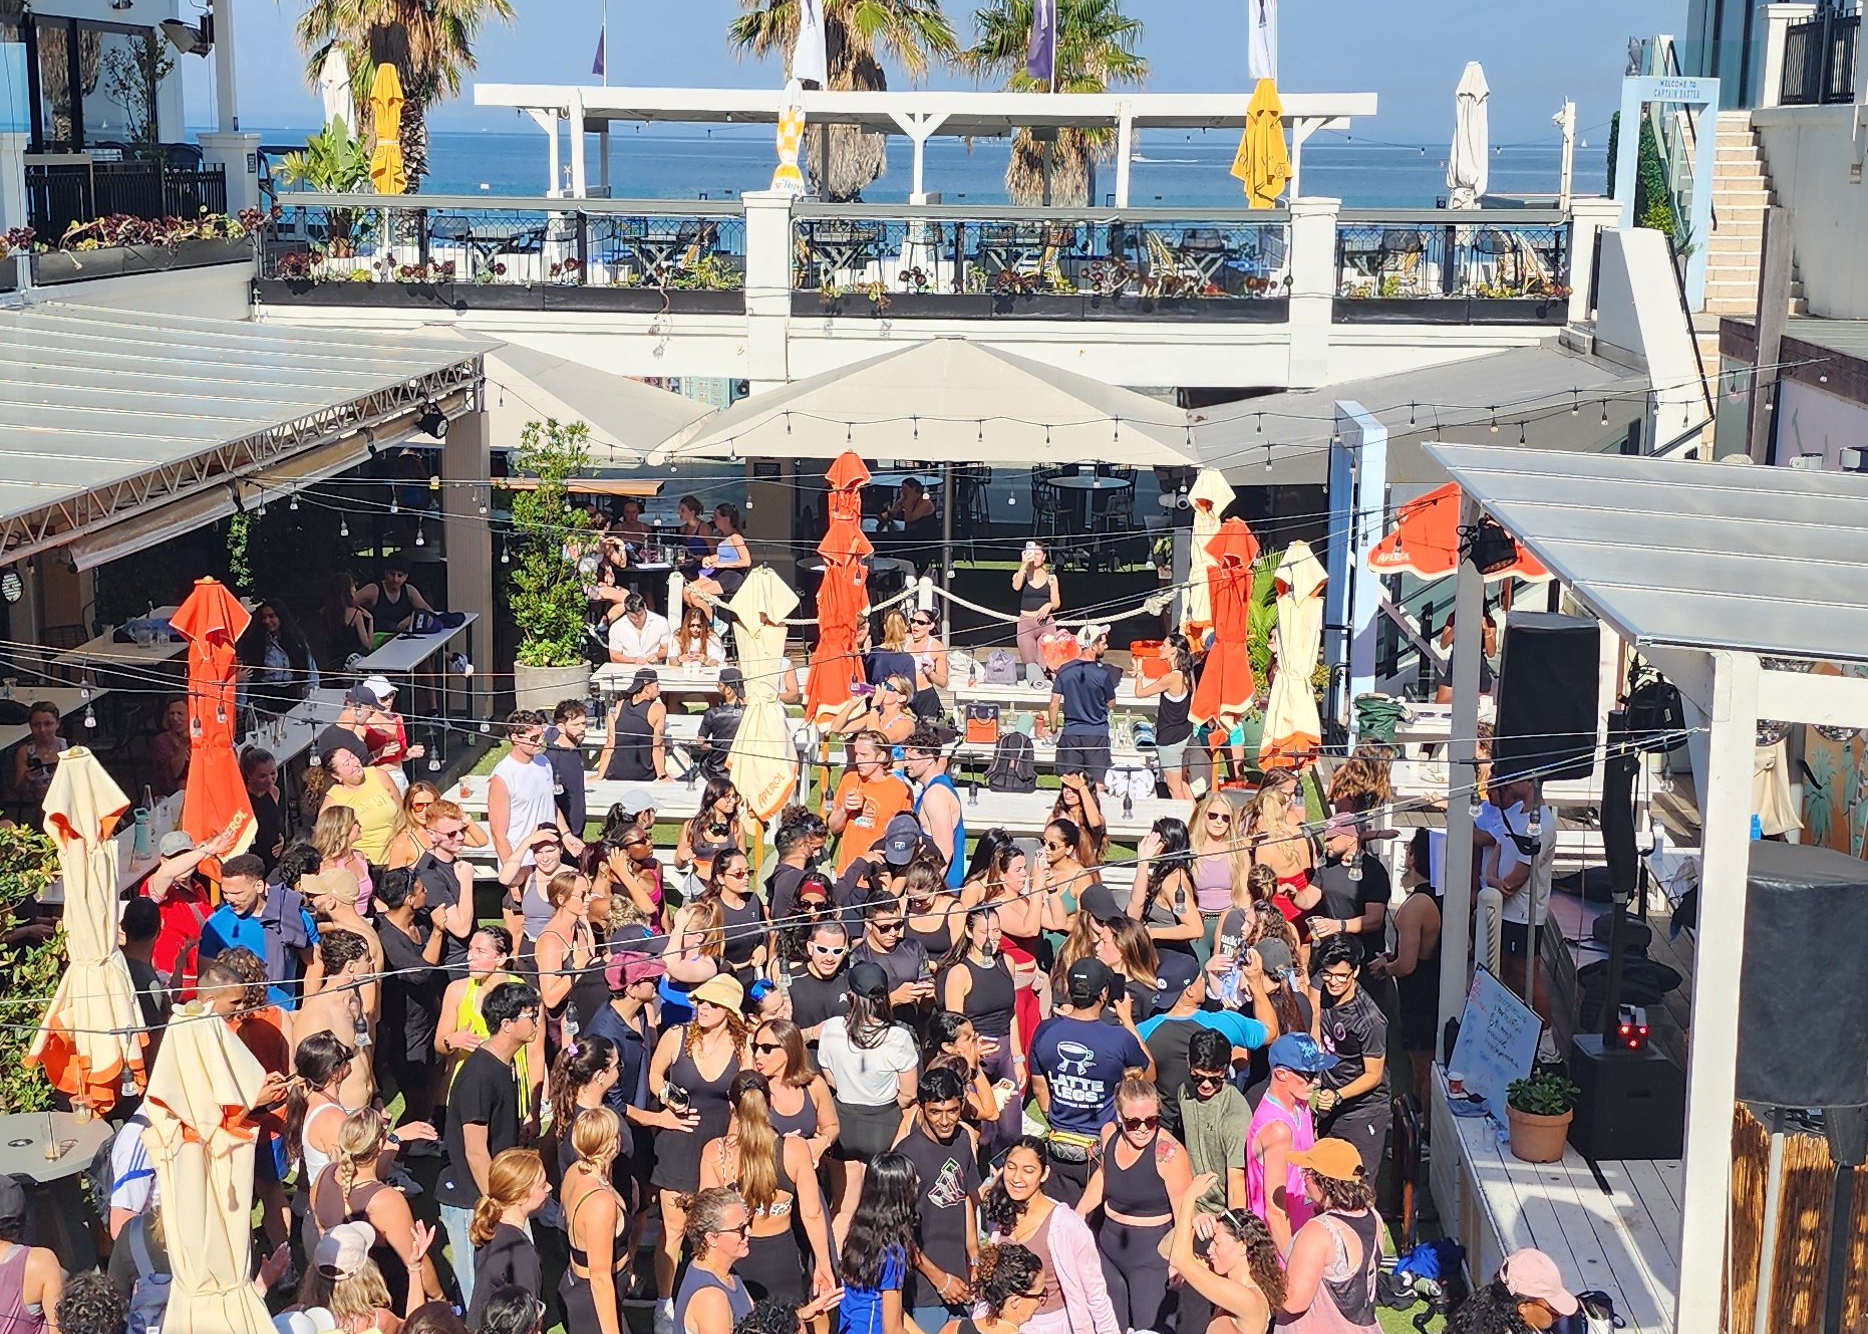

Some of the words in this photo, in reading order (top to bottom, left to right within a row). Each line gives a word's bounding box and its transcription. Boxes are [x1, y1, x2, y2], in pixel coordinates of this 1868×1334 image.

[1653, 89, 1678, 98] CAPTAIN
[758, 772, 786, 809] APEROL
[1047, 1070, 1105, 1093] LATTE
[1053, 1083, 1099, 1103] LEGS
